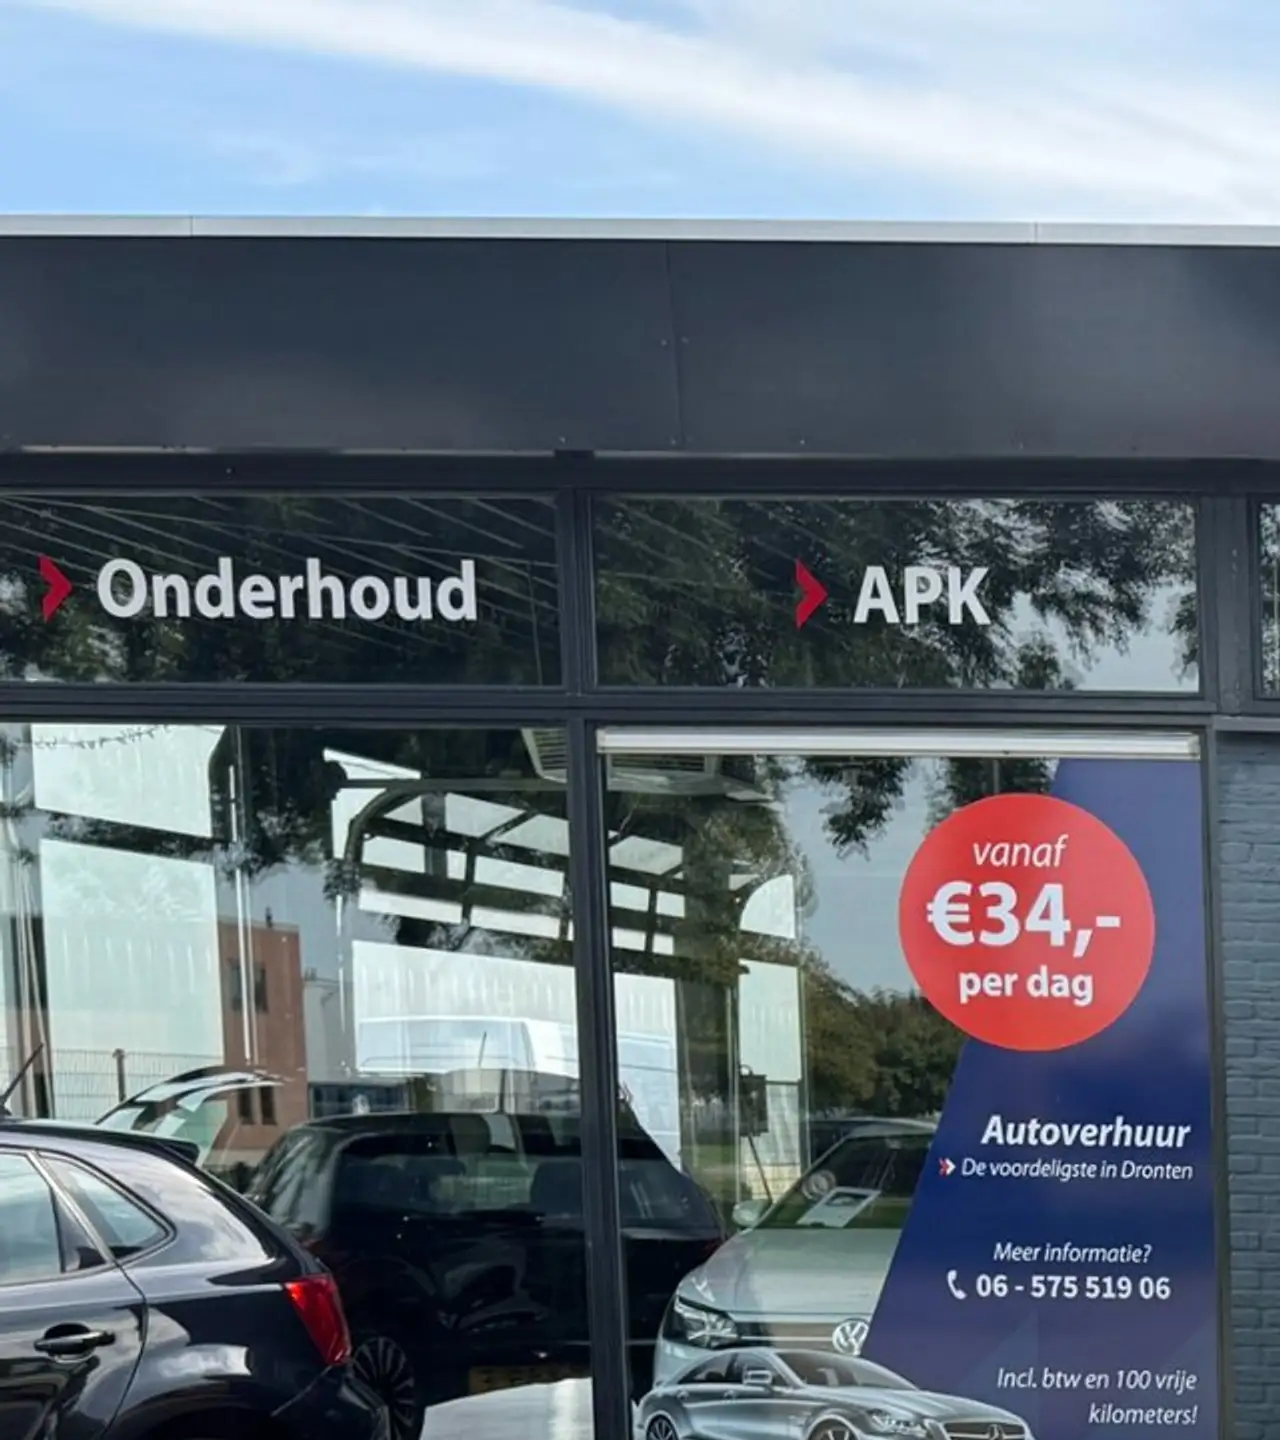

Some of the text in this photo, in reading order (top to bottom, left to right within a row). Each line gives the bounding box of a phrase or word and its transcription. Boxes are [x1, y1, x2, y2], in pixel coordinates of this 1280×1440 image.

[97, 556, 478, 621] Onderhoud
[853, 564, 992, 626] APK
[972, 832, 1070, 869] vanaf
[926, 880, 1121, 958] €34,-
[958, 964, 1094, 1008] per dag
[980, 1115, 1192, 1149] Autoverhuur
[962, 1157, 1193, 1183] De voordeligste in Dronten
[993, 1242, 1152, 1264] Meer informatie?
[976, 1274, 1008, 1297] 06
[1031, 1275, 1078, 1298] 575
[1085, 1276, 1132, 1299] 519
[1139, 1276, 1171, 1300] 06
[997, 1367, 1197, 1395] Incl. btw en 100 vrije
[1088, 1403, 1198, 1425] kilometers!
